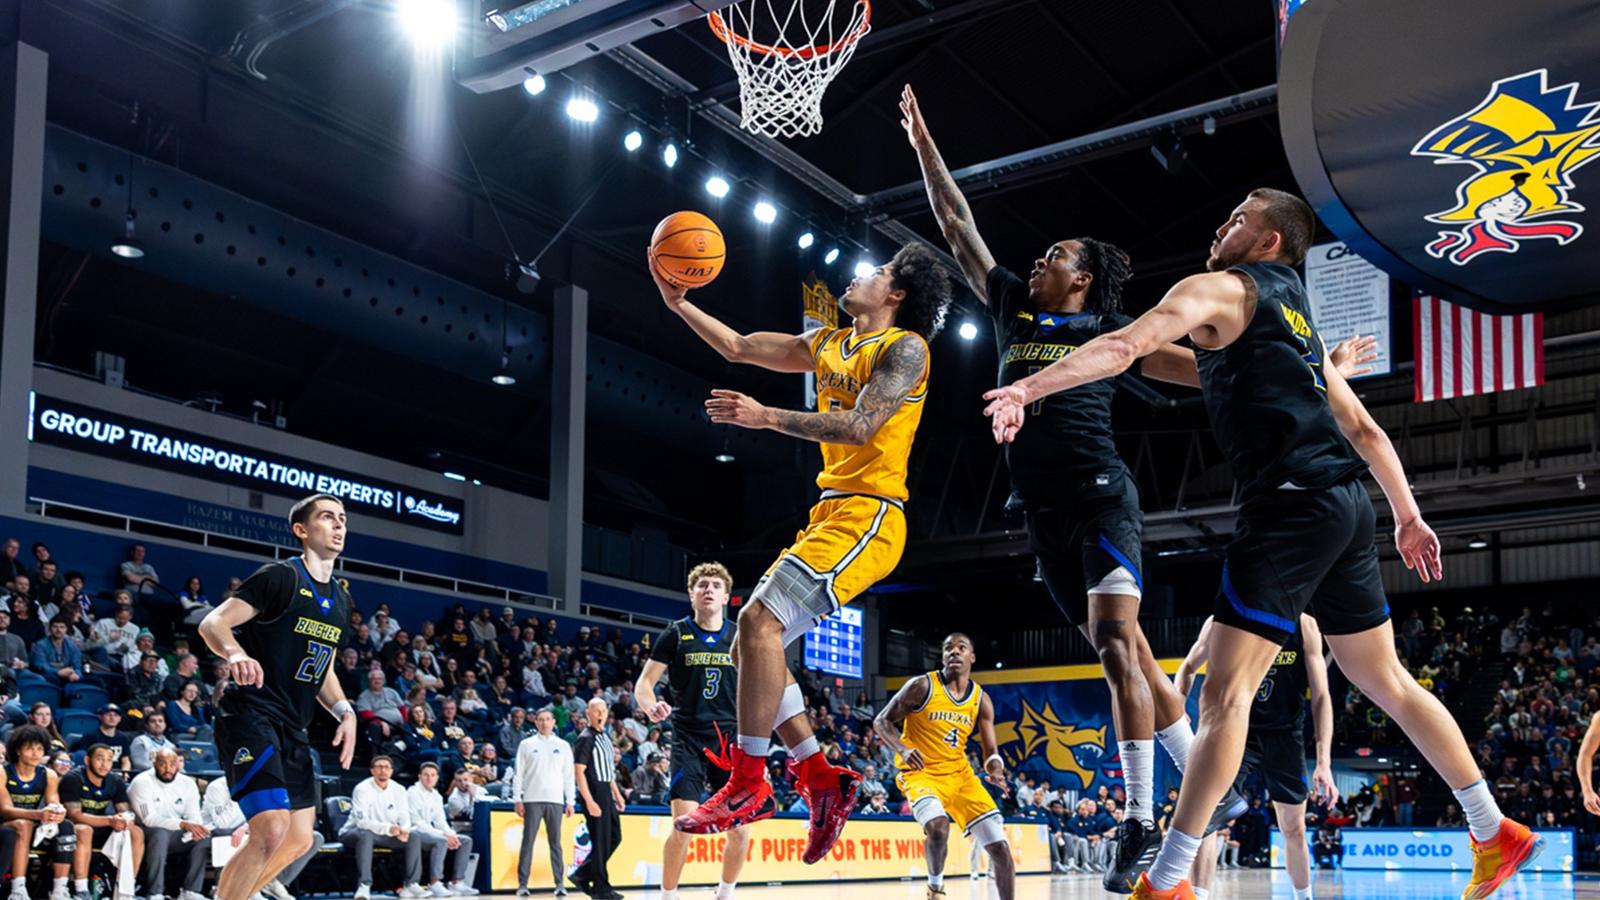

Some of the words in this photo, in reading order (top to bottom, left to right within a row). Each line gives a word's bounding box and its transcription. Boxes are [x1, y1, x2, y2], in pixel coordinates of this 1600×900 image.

[1326, 246, 1355, 260] CA
[1006, 342, 1042, 364] BLUE
[1040, 343, 1079, 361] HEN
[40, 409, 125, 445] GROUP
[129, 429, 315, 490] TRANSPORTATION
[316, 474, 395, 508] EXPERTS
[321, 624, 342, 643] HEN
[641, 633, 650, 649] 4
[295, 640, 333, 682] 20
[685, 652, 712, 667] BLUE
[711, 652, 733, 667] HEN
[1273, 651, 1297, 665] ENS
[703, 667, 722, 699] 3
[1257, 668, 1278, 702] 5
[943, 727, 959, 748] 4
[685, 837, 755, 864] CRISY
[761, 838, 805, 862] PUFF
[824, 838, 856, 861] OR
[861, 838, 892, 860] THE
[1362, 843, 1399, 857] AND
[1404, 843, 1454, 857] GOLD
